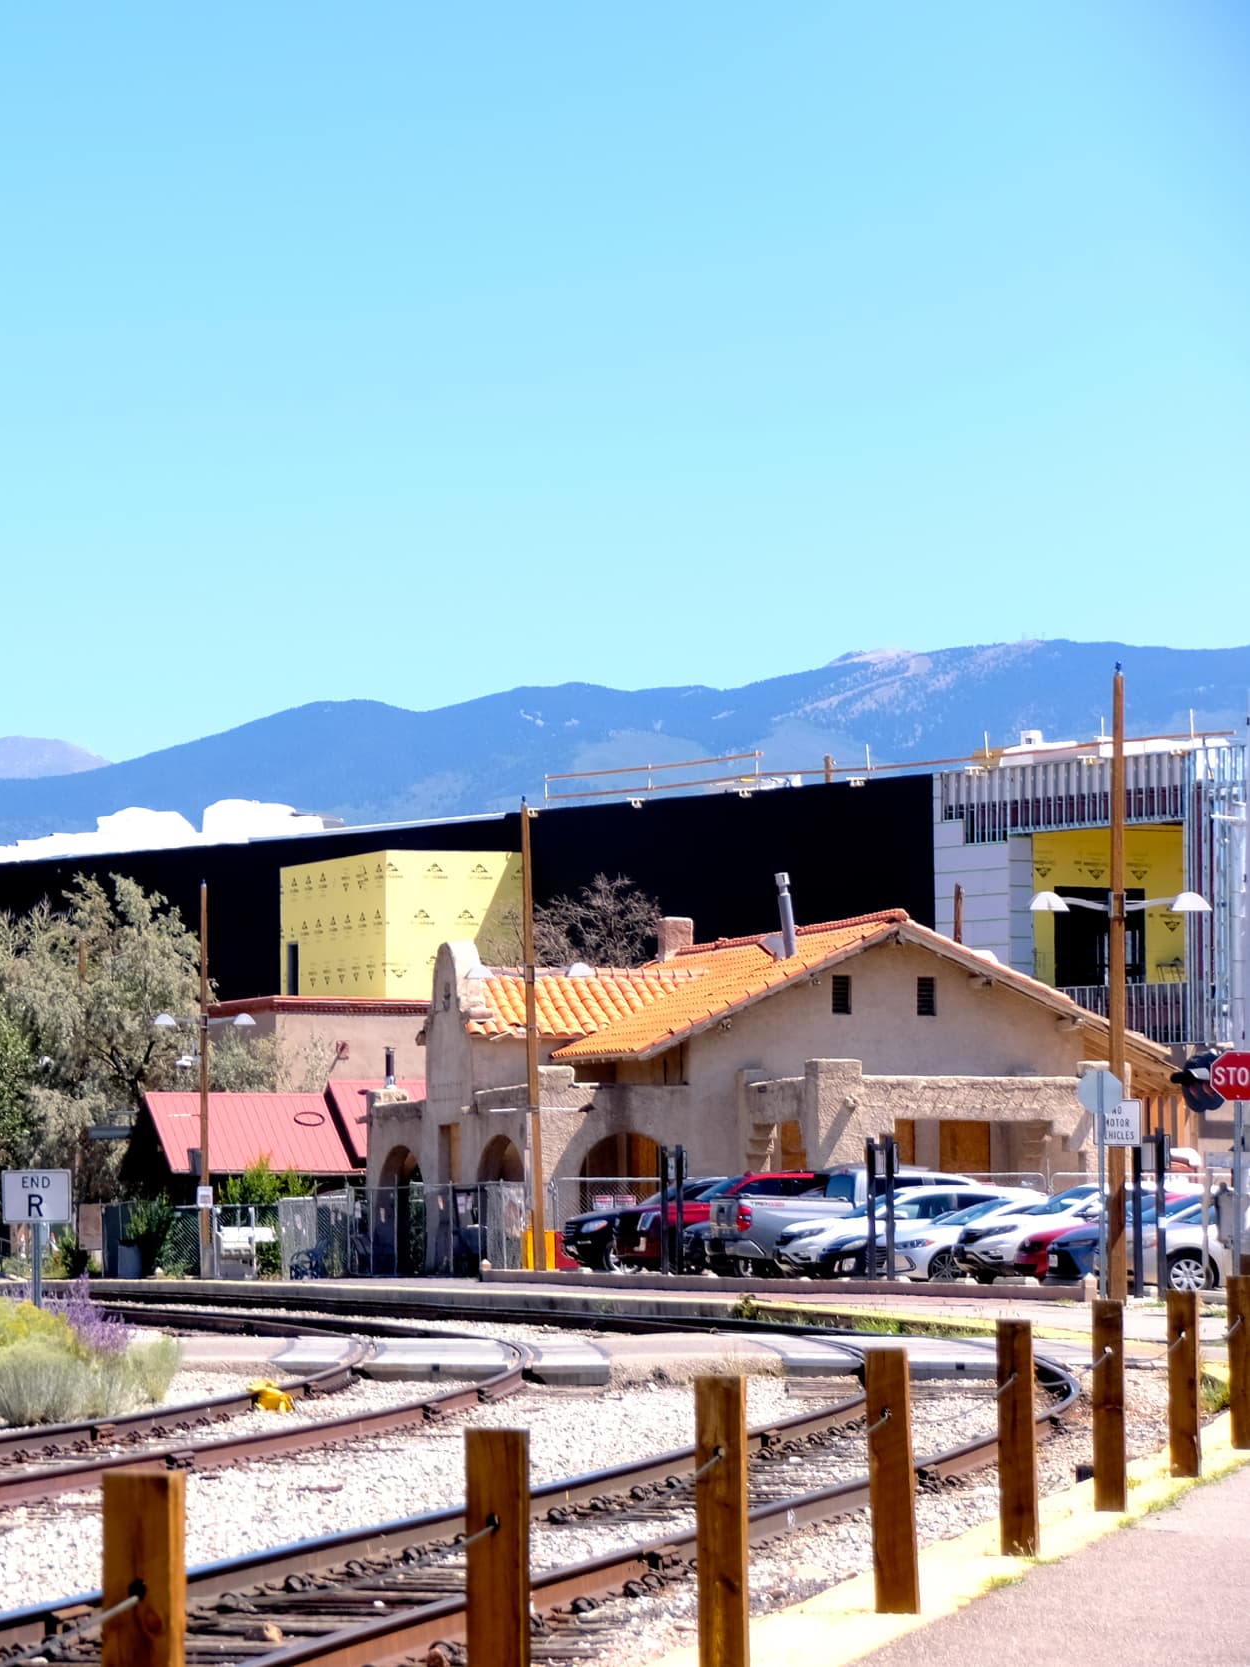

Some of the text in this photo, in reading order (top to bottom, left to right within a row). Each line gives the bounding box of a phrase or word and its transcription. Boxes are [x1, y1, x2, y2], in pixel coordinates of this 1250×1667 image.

[1213, 1066, 1249, 1086] STO
[21, 1176, 51, 1189] END
[28, 1193, 43, 1217] R
